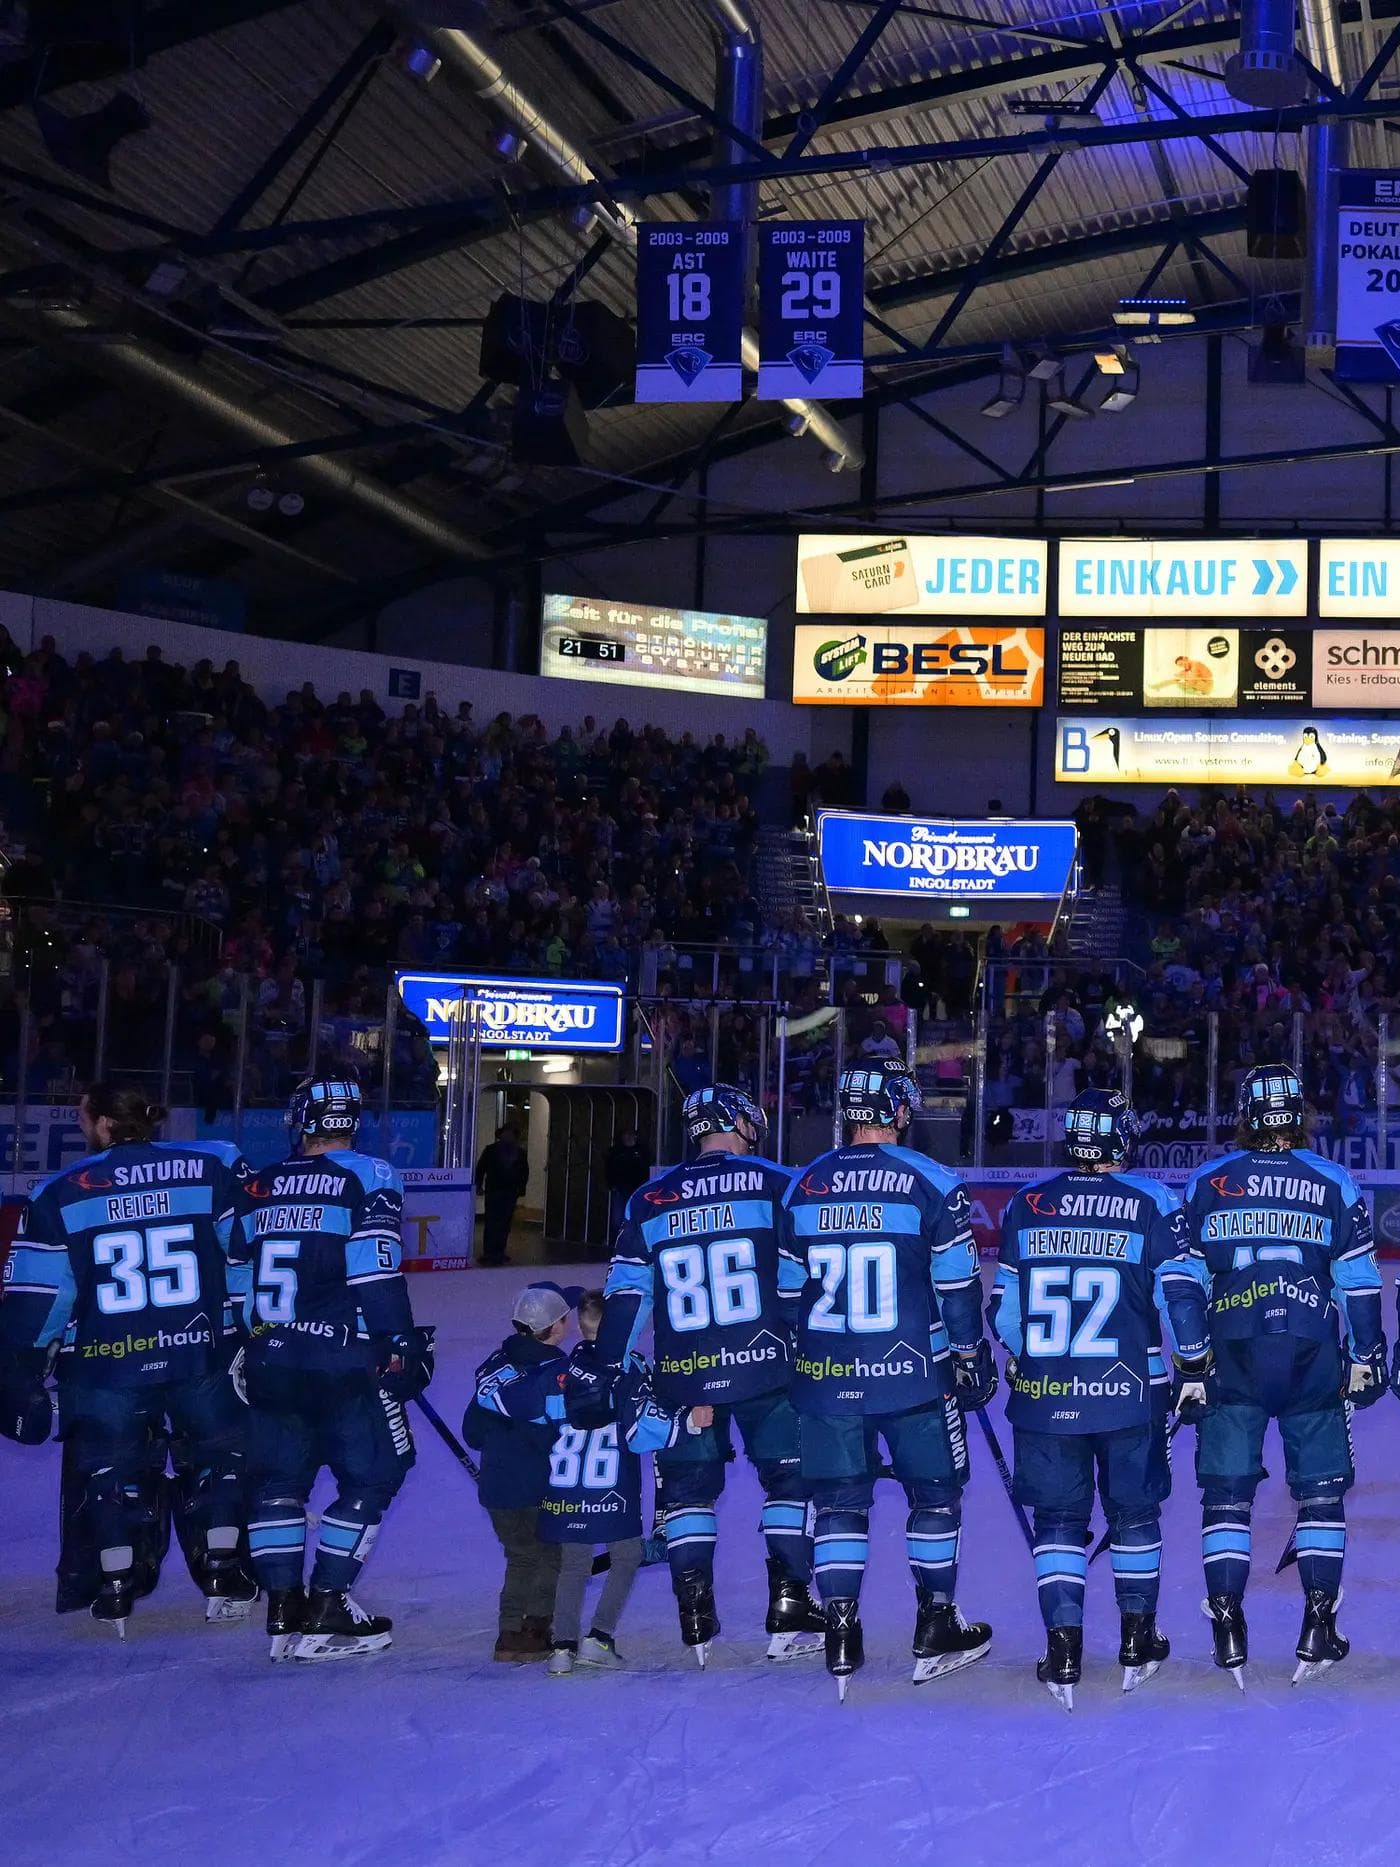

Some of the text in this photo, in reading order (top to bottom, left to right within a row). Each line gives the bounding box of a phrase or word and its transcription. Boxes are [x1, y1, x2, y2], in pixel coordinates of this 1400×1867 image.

[672, 252, 705, 270] AST
[787, 251, 837, 268] WAITE
[667, 273, 710, 321] 18
[781, 271, 840, 319] 29
[671, 333, 705, 343] ERC
[794, 331, 827, 341] ERC
[852, 565, 890, 581] SATURN
[865, 574, 891, 589] CARD
[926, 559, 1040, 594] JEDER
[1075, 560, 1237, 595] EINKAUF
[1328, 561, 1387, 597] EIN
[608, 609, 643, 626] für
[650, 615, 683, 630] die
[563, 640, 617, 659] 21 51
[1062, 642, 1105, 651] WEG ZUM
[1063, 632, 1136, 642] DER EINFACHSTE
[635, 644, 763, 667] COMPUTER
[838, 652, 860, 671] LIFT
[873, 643, 1028, 676] BESL
[1062, 652, 1094, 661] NEUEN
[1253, 681, 1296, 691] elements
[1326, 674, 1351, 685] Kies
[1134, 732, 1193, 745] Linux/Open
[1195, 732, 1229, 743] Source
[1327, 733, 1370, 745] Training,
[863, 839, 1039, 876] NORDBRÄU
[909, 877, 996, 890] INGOLSTADT
[114, 1158, 204, 1187] SATURN
[272, 1174, 347, 1197] SATURN
[427, 1173, 454, 1181] Audi
[681, 1171, 764, 1199] SATURN
[832, 1169, 915, 1195] SATURN
[1073, 1175, 1104, 1183] BAUER
[1247, 1175, 1326, 1206] SATURN
[107, 1191, 170, 1222] REICH
[255, 1206, 323, 1235] WAGNER
[668, 1204, 735, 1238] PIETTA
[818, 1204, 883, 1233] QUAAS
[1059, 1194, 1140, 1221] SATURN
[1208, 1210, 1324, 1242] STACHOWIAK
[376, 1236, 394, 1271] 5
[1027, 1229, 1130, 1259] HENRIQUEZ
[93, 1223, 200, 1315] 35
[255, 1240, 301, 1322] 5
[659, 1237, 763, 1333] 86
[807, 1241, 899, 1335] 20
[1215, 1276, 1320, 1313] zieglerhaus
[1026, 1266, 1121, 1358] 52
[82, 1330, 211, 1360] zieglerhaus
[660, 1345, 777, 1376] zieglerhaus
[796, 1351, 914, 1381] zieglerhaus
[1014, 1371, 1131, 1400] zieglerhaus
[379, 1388, 411, 1456] SATURN
[943, 1396, 968, 1470] SATURN
[549, 1422, 621, 1489] 86
